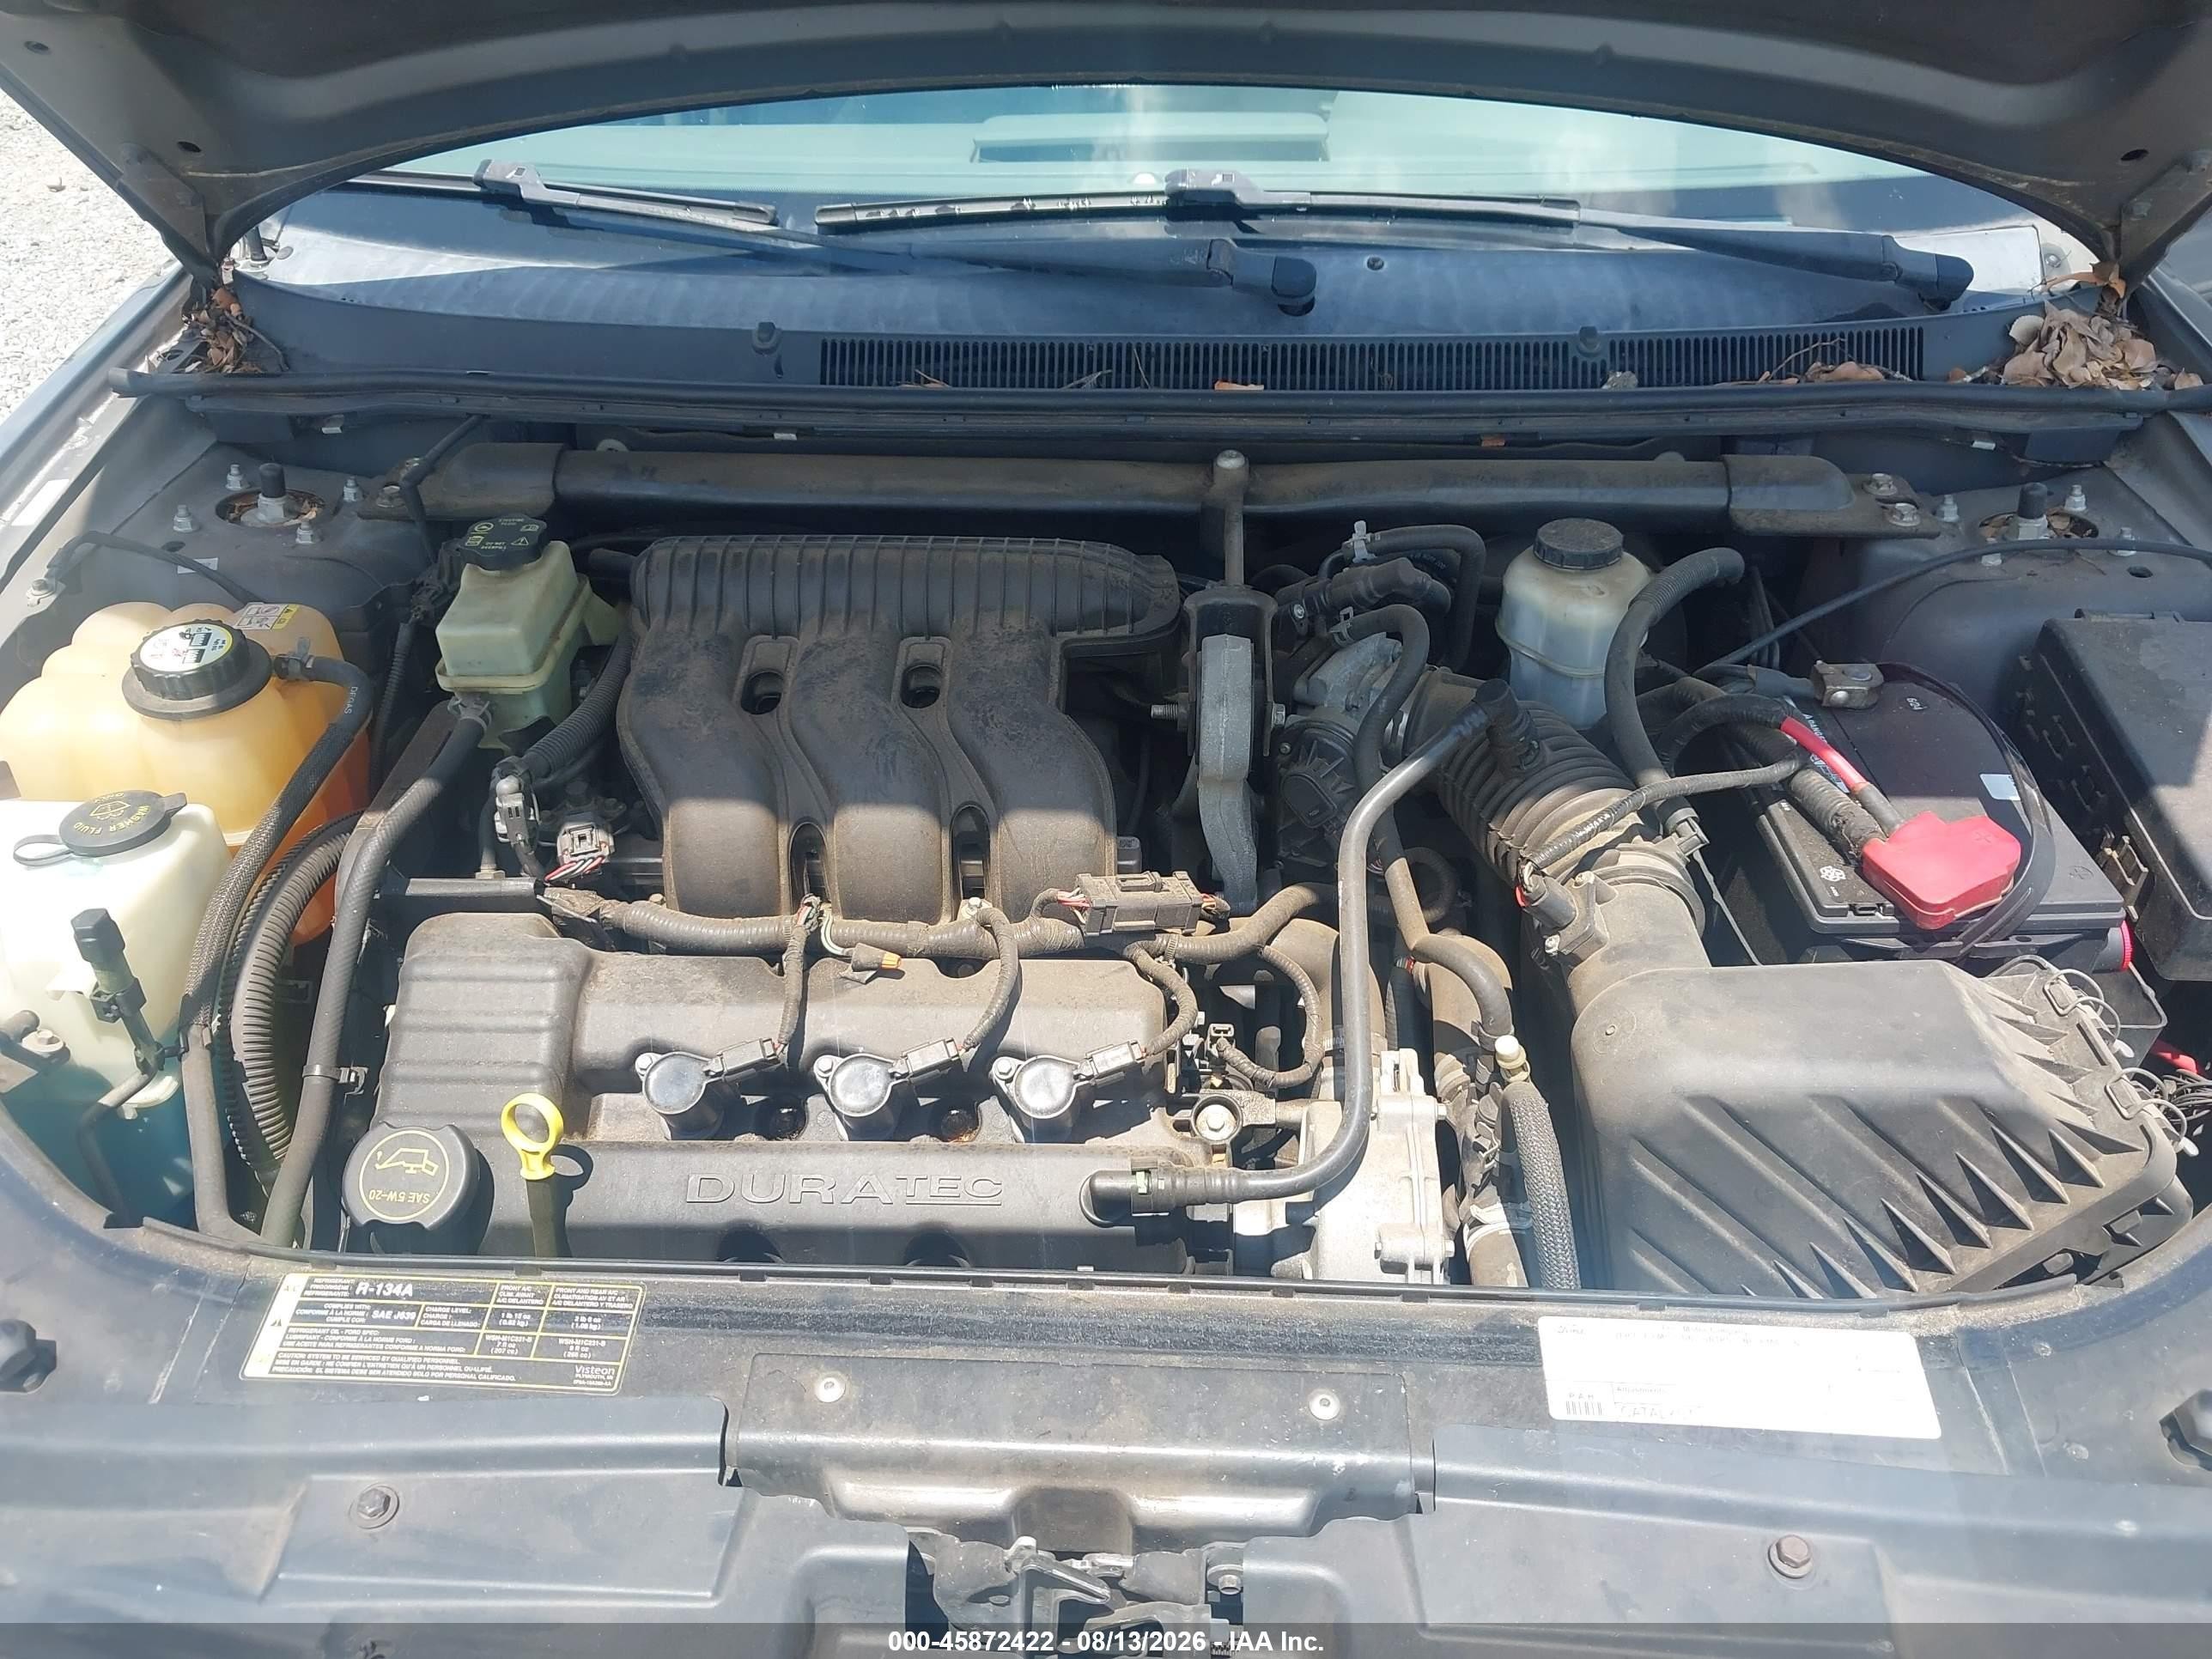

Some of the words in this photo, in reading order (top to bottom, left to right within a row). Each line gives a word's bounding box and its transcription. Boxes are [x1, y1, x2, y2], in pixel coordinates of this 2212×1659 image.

[109, 805, 150, 832] WASHER
[73, 821, 103, 836] FLUID
[368, 1188, 405, 1202] 5W-20
[686, 1174, 1003, 1204] DURATEC
[406, 1192, 431, 1204] SAE
[355, 1281, 413, 1297] R-134A
[371, 1310, 394, 1319] SAE
[394, 1311, 416, 1320] J639
[574, 1365, 616, 1376] Visteon
